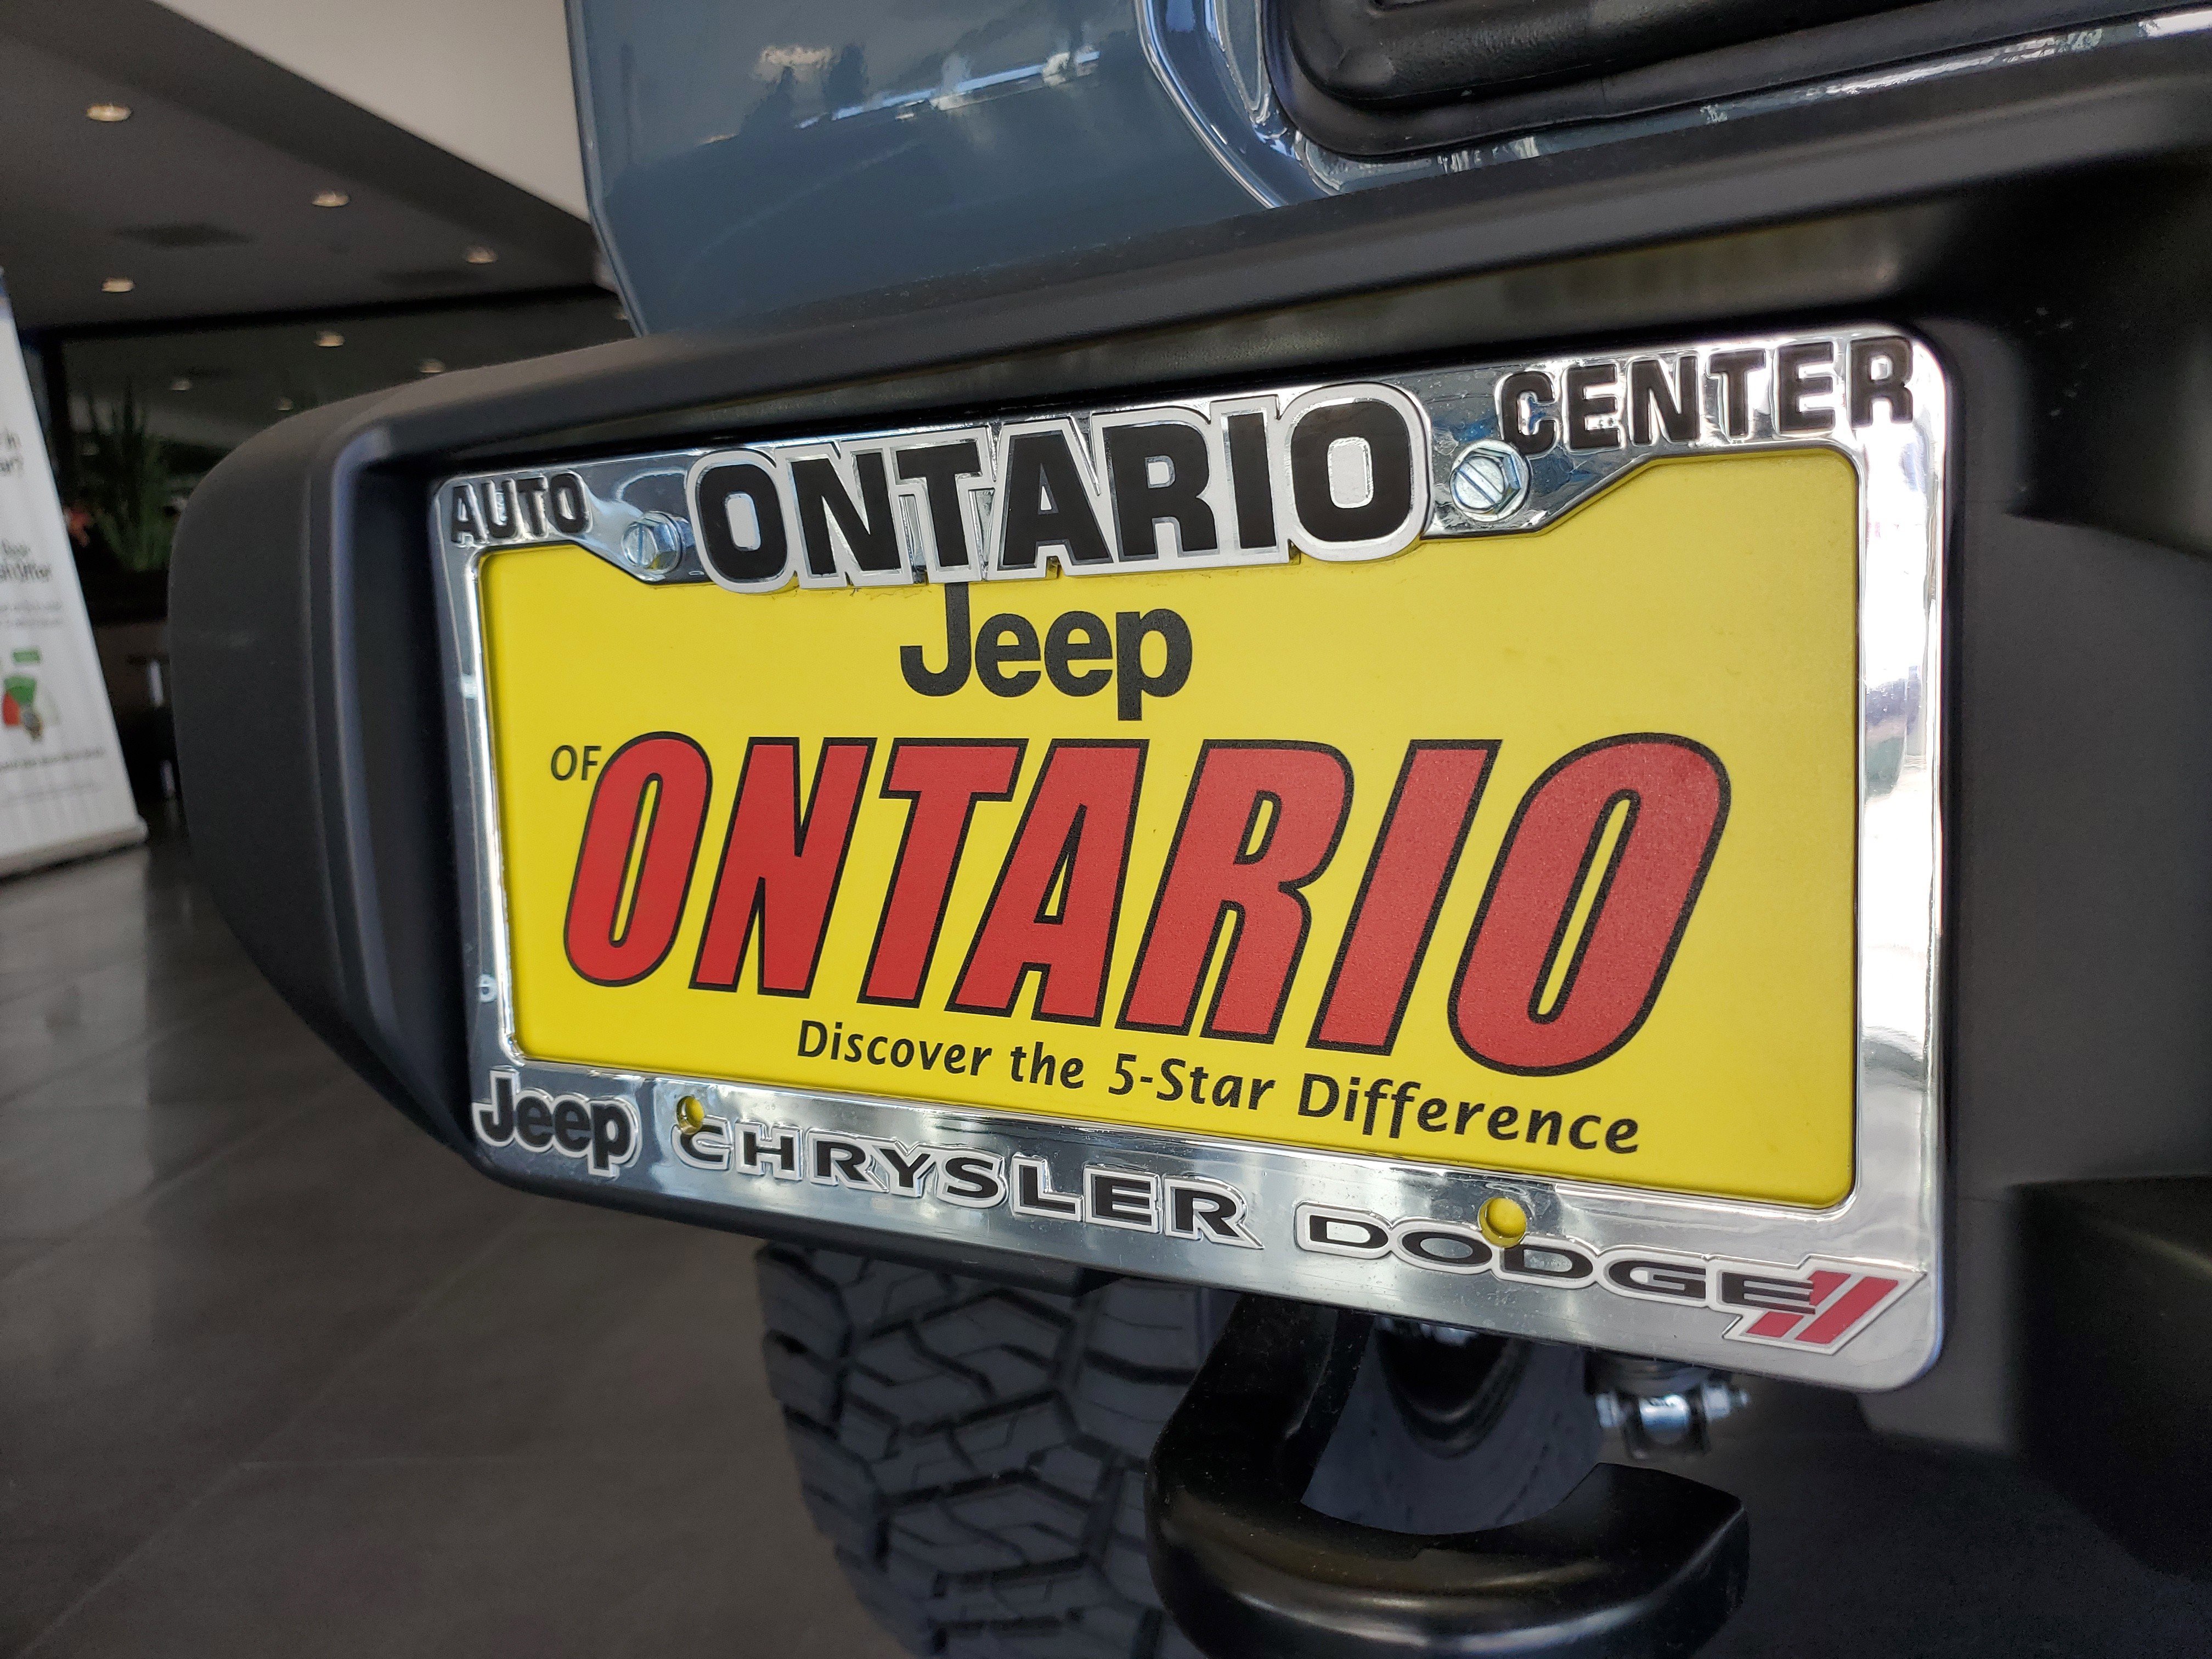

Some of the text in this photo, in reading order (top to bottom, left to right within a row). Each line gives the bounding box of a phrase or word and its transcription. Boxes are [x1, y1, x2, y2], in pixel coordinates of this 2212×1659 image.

[450, 335, 1915, 594] AUTO ONTARIO CENTER
[900, 583, 1194, 721] Jeep
[551, 731, 1731, 1077] OF ONTARIO
[472, 1066, 1818, 1317] Jeep CHRYSLER DODGE
[797, 1019, 1640, 1154] Discover the 5-Star Difference
